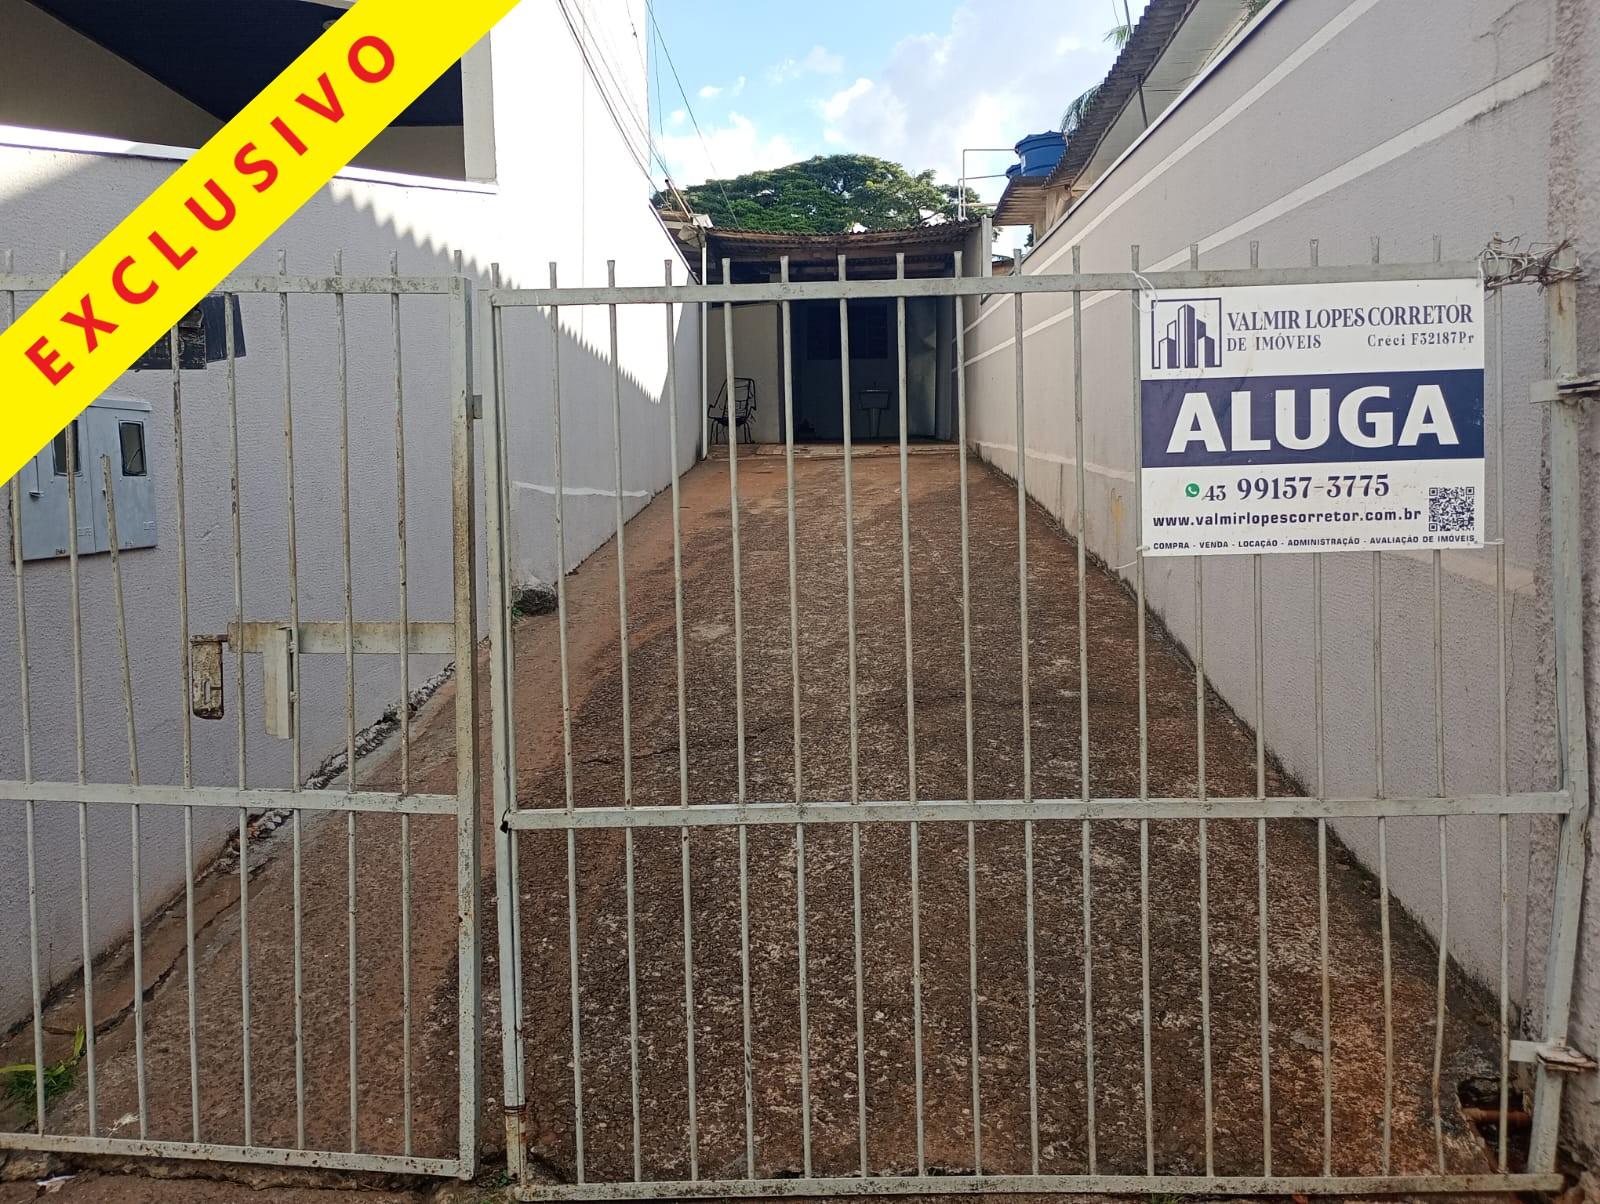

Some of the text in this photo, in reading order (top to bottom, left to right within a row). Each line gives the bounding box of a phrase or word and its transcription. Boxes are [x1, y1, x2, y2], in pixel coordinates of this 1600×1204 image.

[1227, 304, 1473, 331] VALMIR LOPES CORRETOR
[1227, 333, 1322, 351] DE IMÓVEIS
[1368, 333, 1405, 347] Creci
[1166, 384, 1460, 454] ALUGA
[1203, 474, 1390, 501] 43 99157-3775
[1153, 508, 1421, 528] www.valmirlopescorretor.com.br
[1153, 542, 1190, 550] COMPRA
[1200, 541, 1229, 549] VENDA
[1238, 539, 1278, 548] LOCAÇÃO
[1288, 537, 1360, 546] ADMINISTRAÇÃO
[1370, 536, 1419, 545] AVALIAÇÃO
